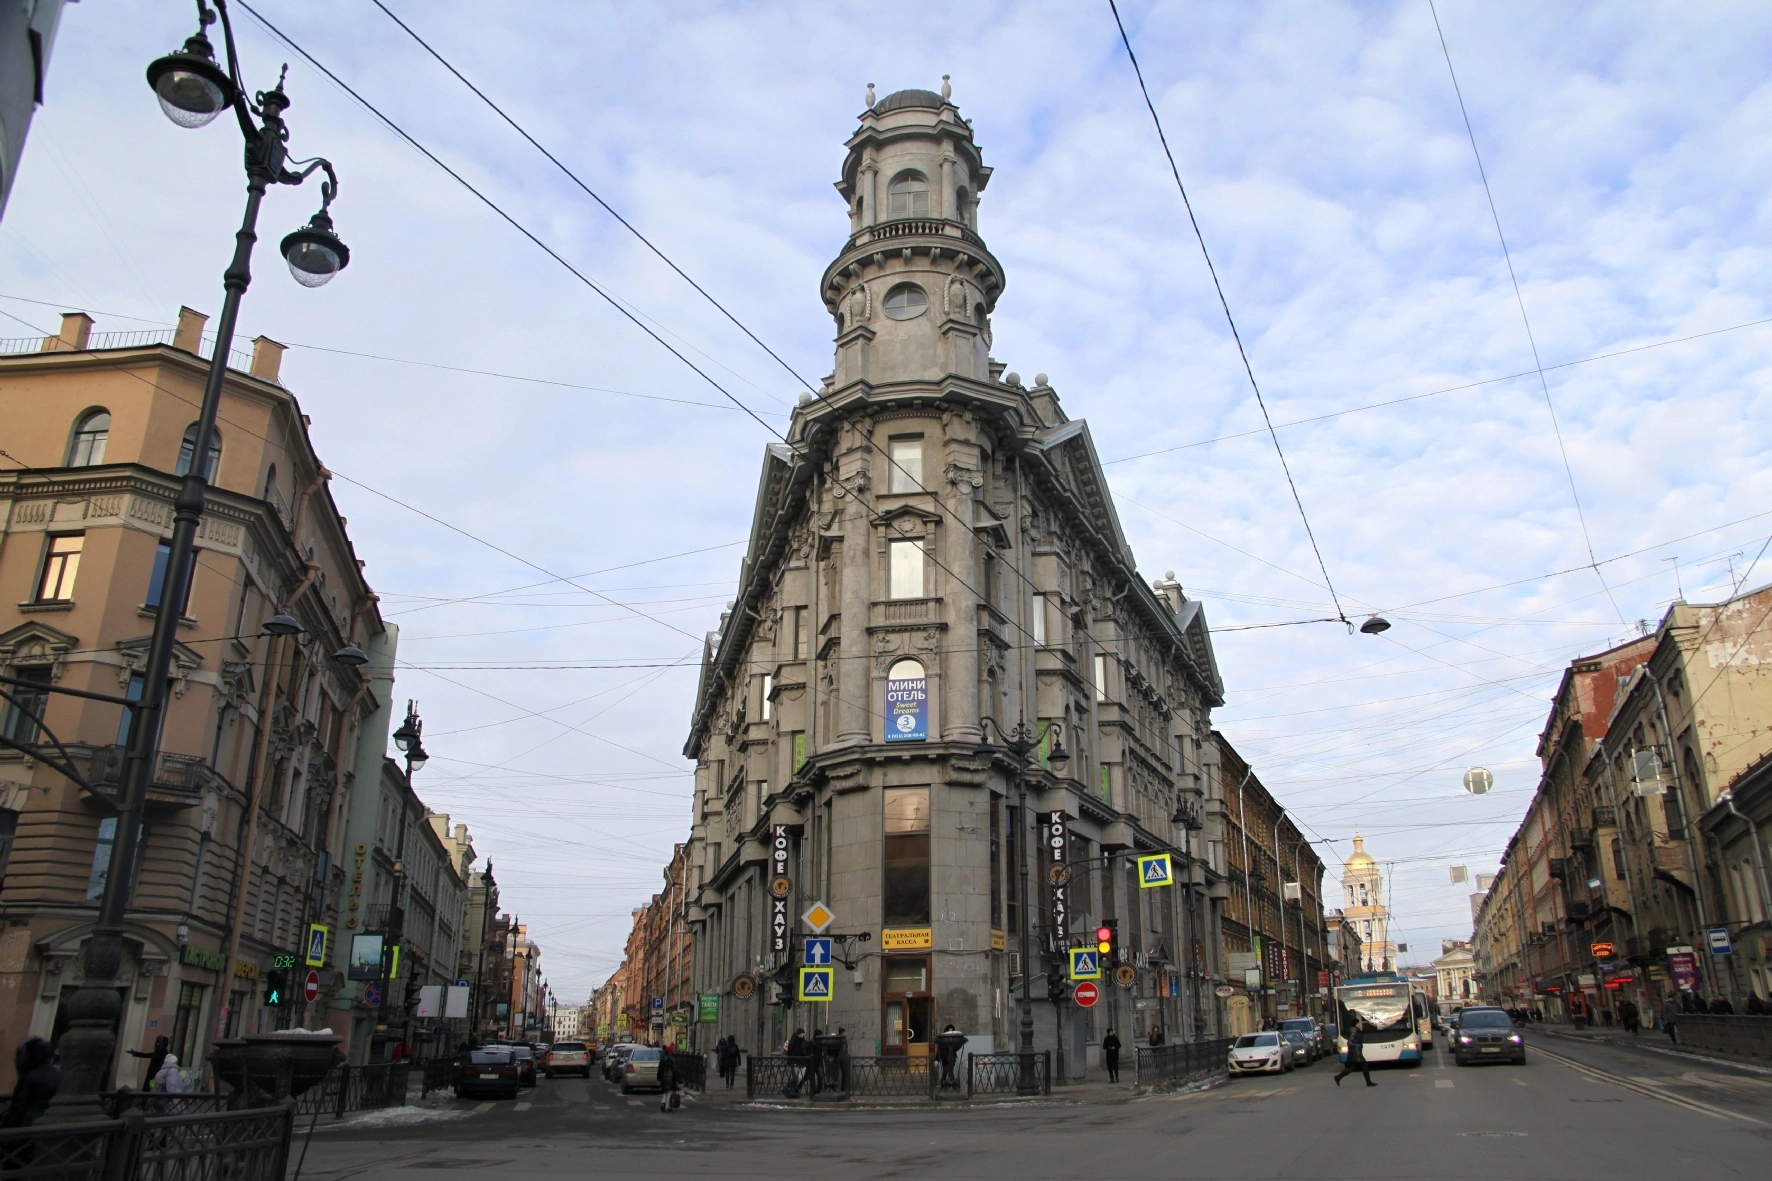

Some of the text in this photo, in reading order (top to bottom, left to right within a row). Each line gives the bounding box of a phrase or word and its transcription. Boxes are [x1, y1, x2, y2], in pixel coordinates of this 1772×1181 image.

[888, 680, 925, 691] МИНИ
[888, 690, 926, 701] ОТЕЛЬ
[903, 716, 910, 726] 3
[774, 825, 787, 874] КОФЕ
[1050, 811, 1064, 861] КОФЕ
[349, 842, 367, 911] ОТЕЛЬ
[774, 901, 785, 950] ХАУЗ
[655, 998, 662, 1007] P
